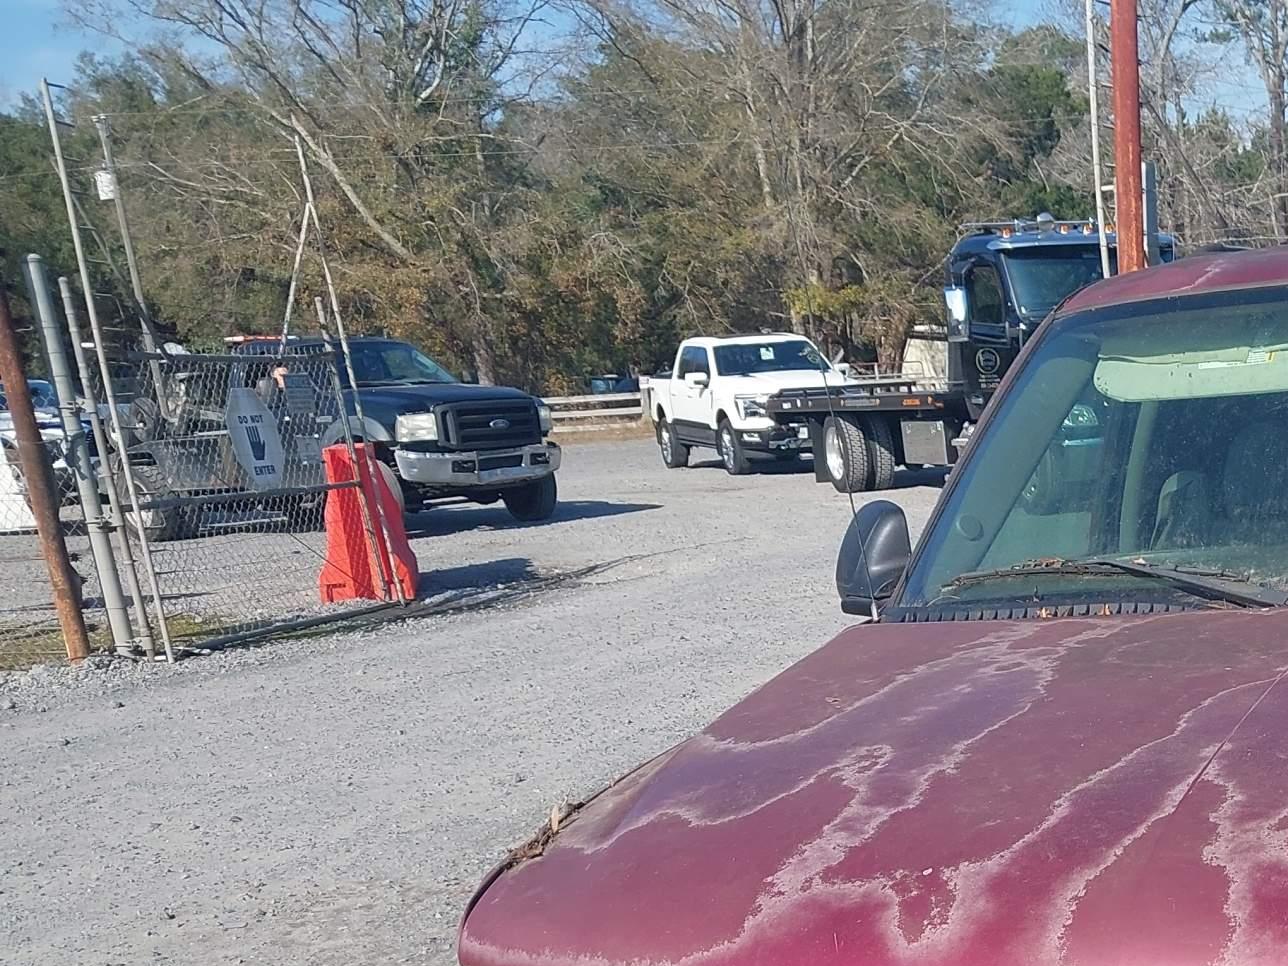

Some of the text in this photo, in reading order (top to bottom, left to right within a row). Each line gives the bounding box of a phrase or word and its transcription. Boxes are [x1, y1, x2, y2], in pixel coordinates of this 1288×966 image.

[237, 414, 264, 425] DO NOT
[254, 465, 277, 476] ENTER
